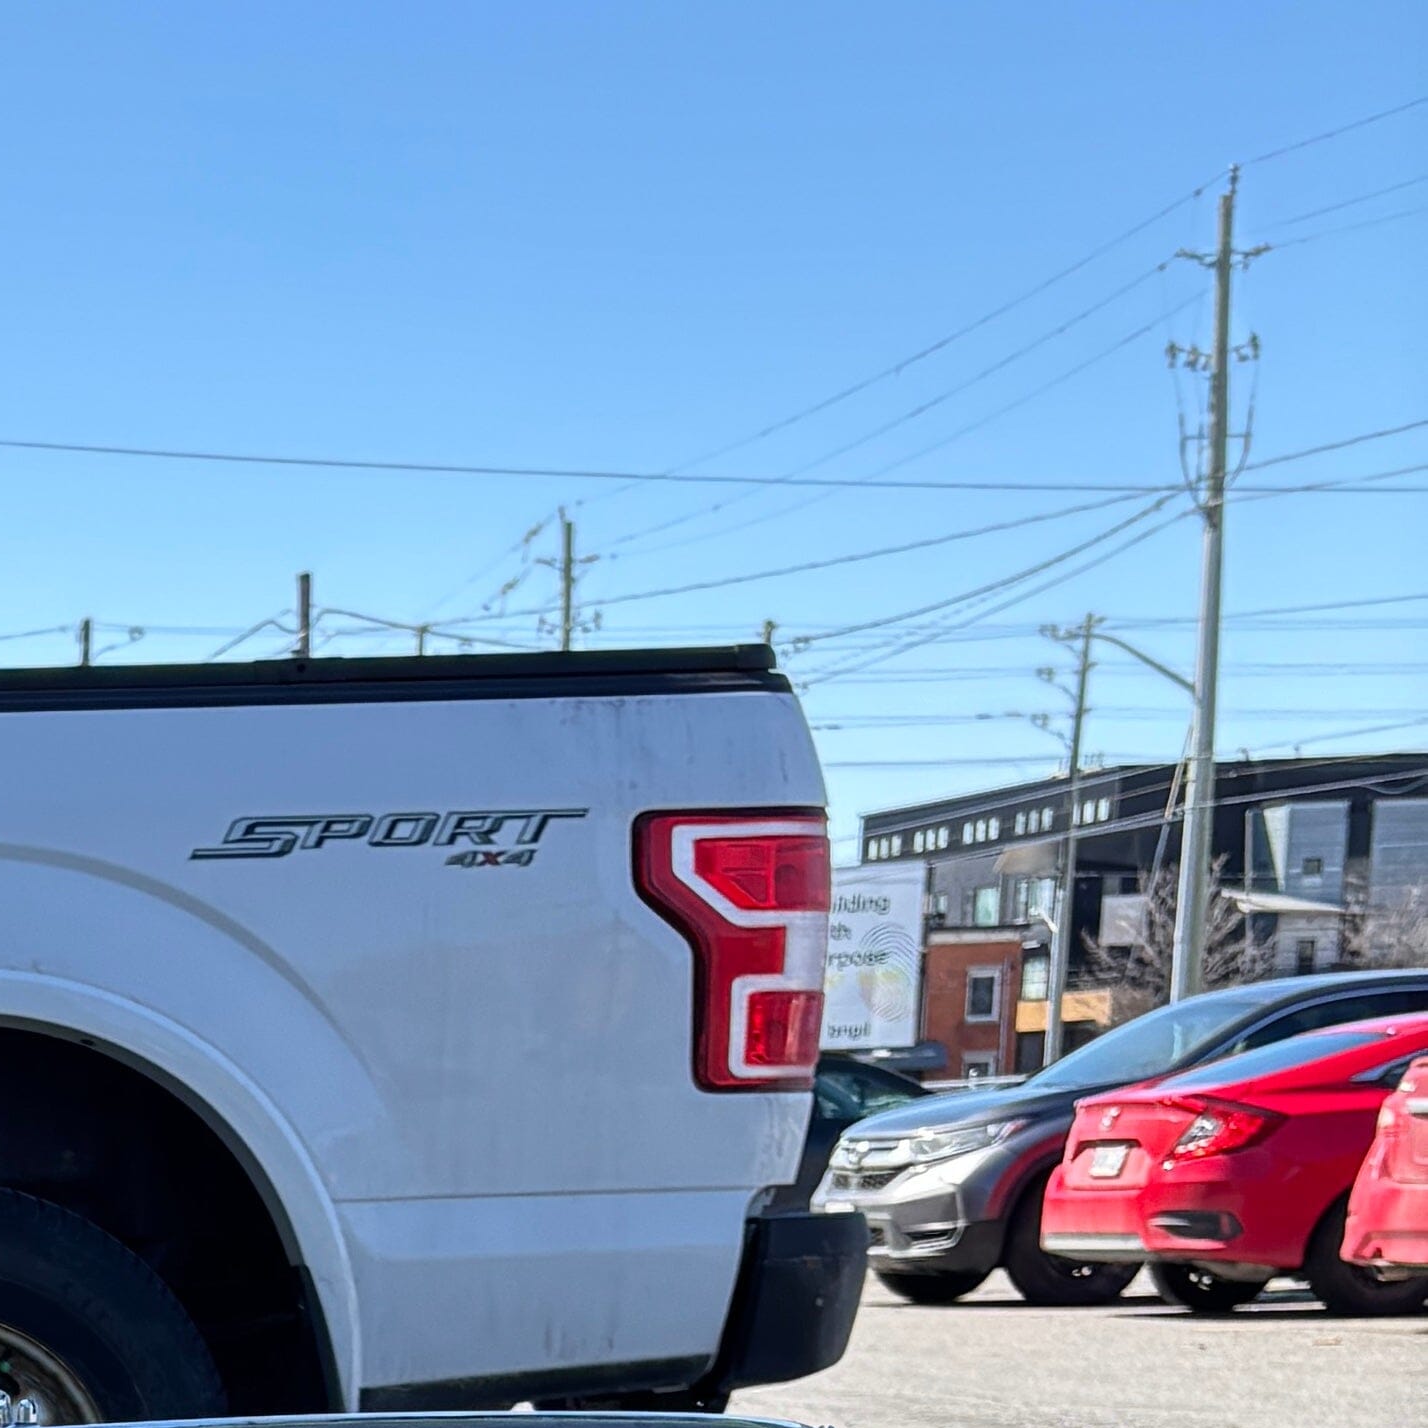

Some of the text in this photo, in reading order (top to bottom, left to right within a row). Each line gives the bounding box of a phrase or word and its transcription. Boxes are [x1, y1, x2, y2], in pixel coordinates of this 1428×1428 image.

[189, 808, 590, 860] SPORT
[832, 893, 891, 916] ilding
[828, 951, 891, 972] rpose
